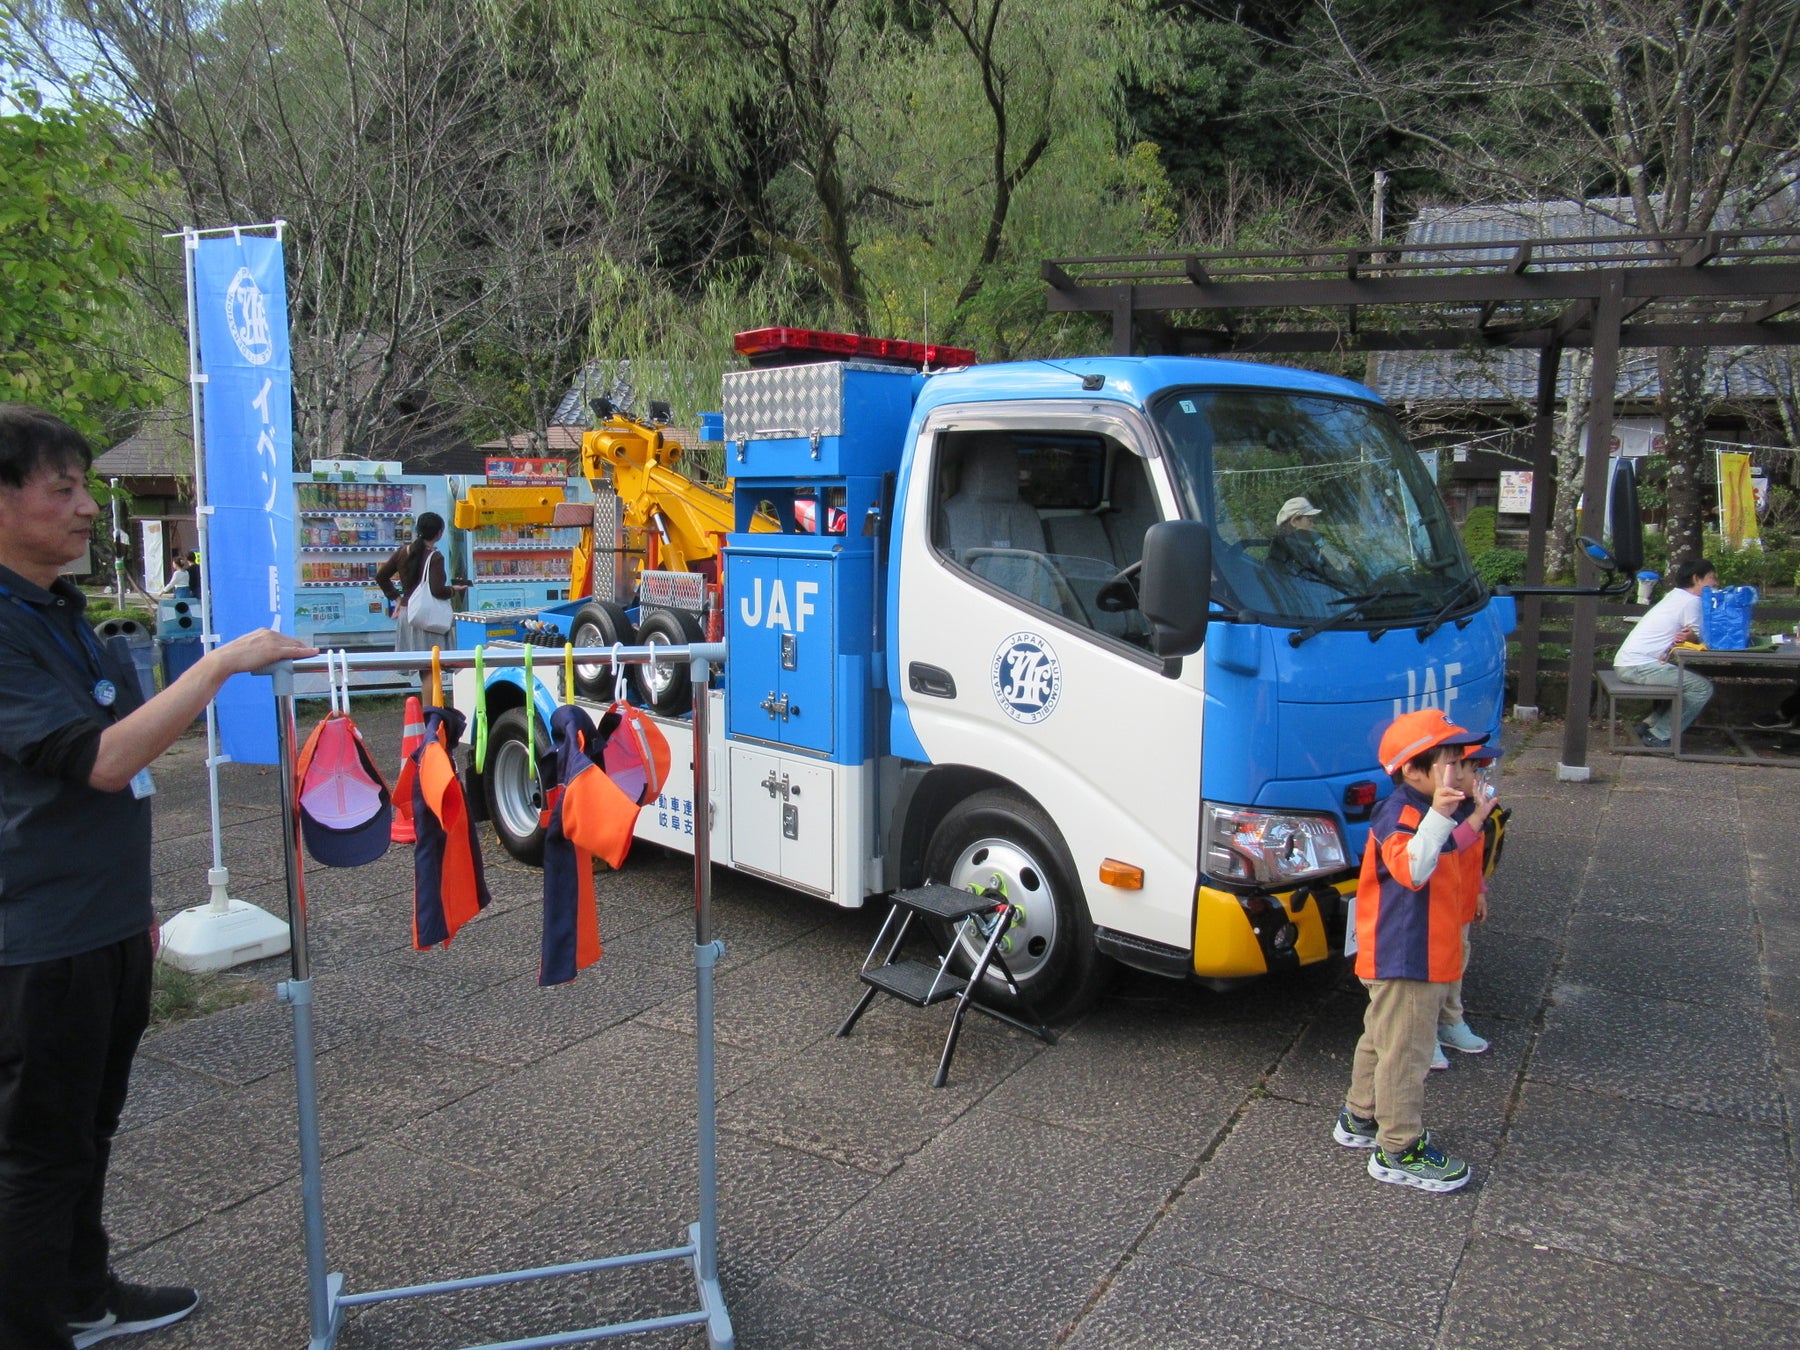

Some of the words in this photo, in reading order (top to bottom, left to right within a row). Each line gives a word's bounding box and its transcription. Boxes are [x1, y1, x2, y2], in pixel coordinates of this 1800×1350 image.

[252, 377, 282, 632] イベン
[740, 577, 819, 633] JAF
[1009, 634, 1046, 649] JAPAN
[992, 654, 1022, 720] FEDERATION
[1030, 658, 1060, 721] AUTOMOBILE
[1393, 662, 1462, 721] JAF
[649, 793, 693, 817] 動車連
